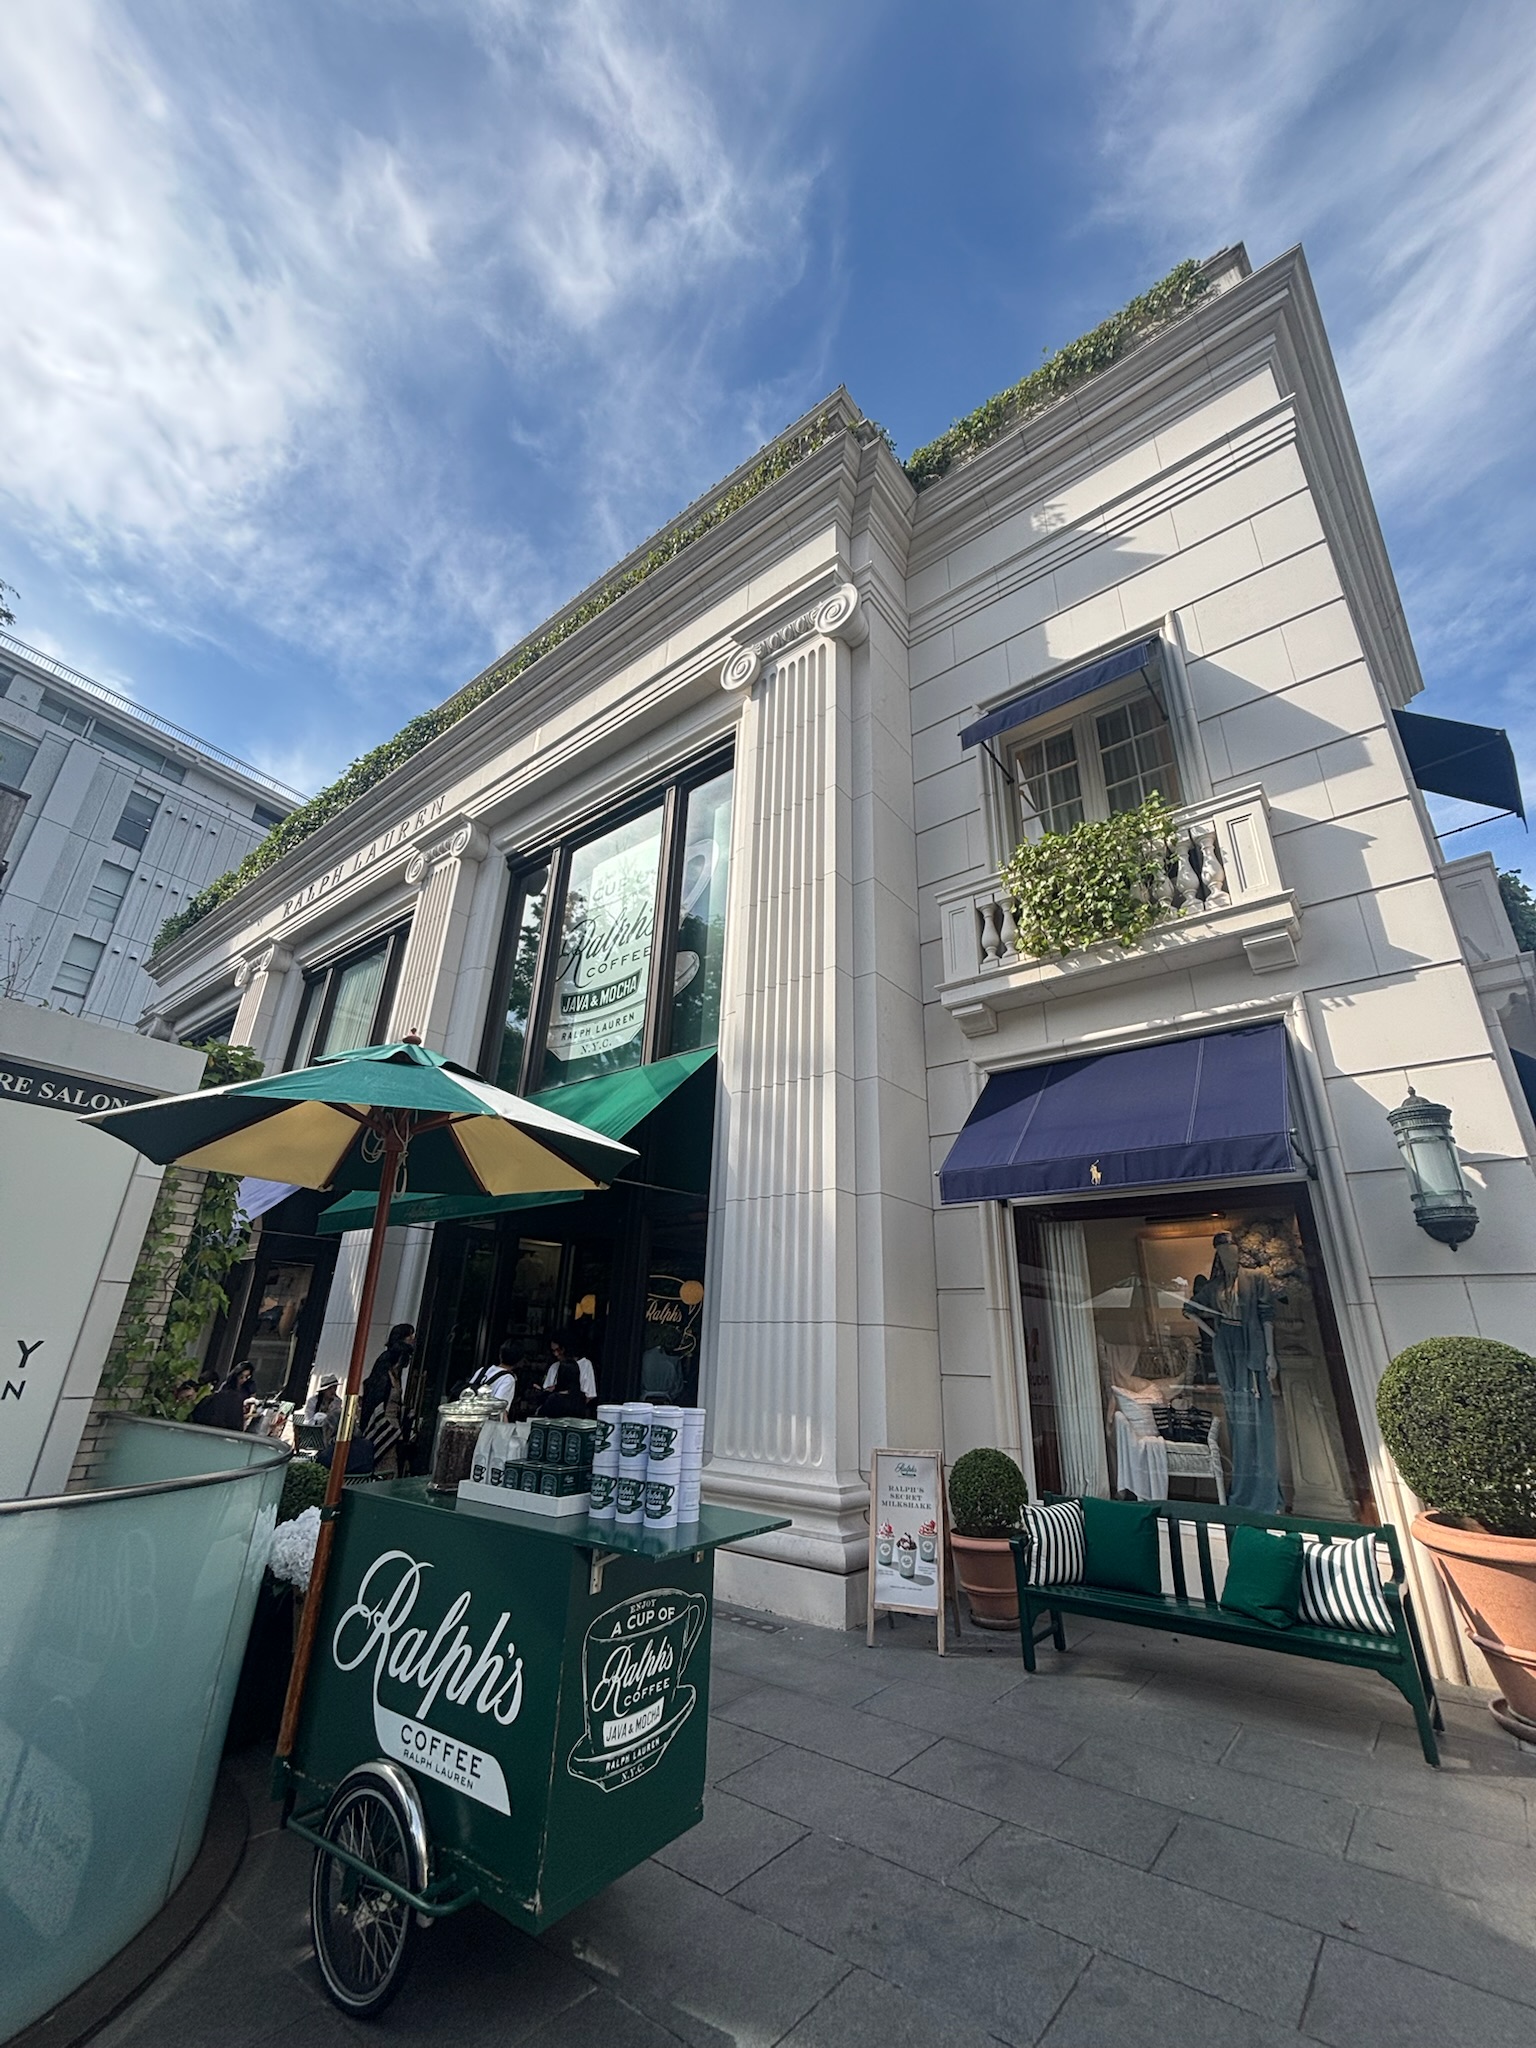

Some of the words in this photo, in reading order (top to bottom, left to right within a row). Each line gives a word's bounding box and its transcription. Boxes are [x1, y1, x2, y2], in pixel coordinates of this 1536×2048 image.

[281, 863, 345, 919] RALPH
[353, 795, 446, 872] LAUREN
[586, 945, 652, 978] COFFEE
[563, 994, 589, 1012] JAVA
[590, 994, 598, 1007] &
[600, 976, 637, 1006] MOCHA
[562, 1028, 591, 1041] RALPH
[596, 1012, 635, 1033] LAUREN
[580, 1039, 612, 1055] N.Y.C.
[38, 1081, 129, 1110] SALON
[881, 1500, 932, 1510] MILKSHAKE
[888, 1485, 924, 1493] RALPH'S
[890, 1493, 922, 1501] SECRET
[610, 1624, 622, 1638] A
[626, 1610, 654, 1630] CUP
[658, 1606, 676, 1621] OF
[630, 1599, 657, 1614] ENJOY
[333, 1550, 523, 1725] Ralph's
[591, 1635, 674, 1718] Ralph's
[623, 1677, 671, 1707] COFFEE
[605, 1721, 627, 1742] JAVA
[628, 1723, 634, 1735] &
[635, 1705, 660, 1731] MOCHA
[401, 1724, 483, 1779] COFFEE
[605, 1756, 631, 1772] RALPH
[632, 1737, 660, 1759] LAUREN
[403, 1749, 432, 1768] RALPH
[435, 1763, 474, 1790] LAUREN
[620, 1763, 645, 1783] N.Y.C.
